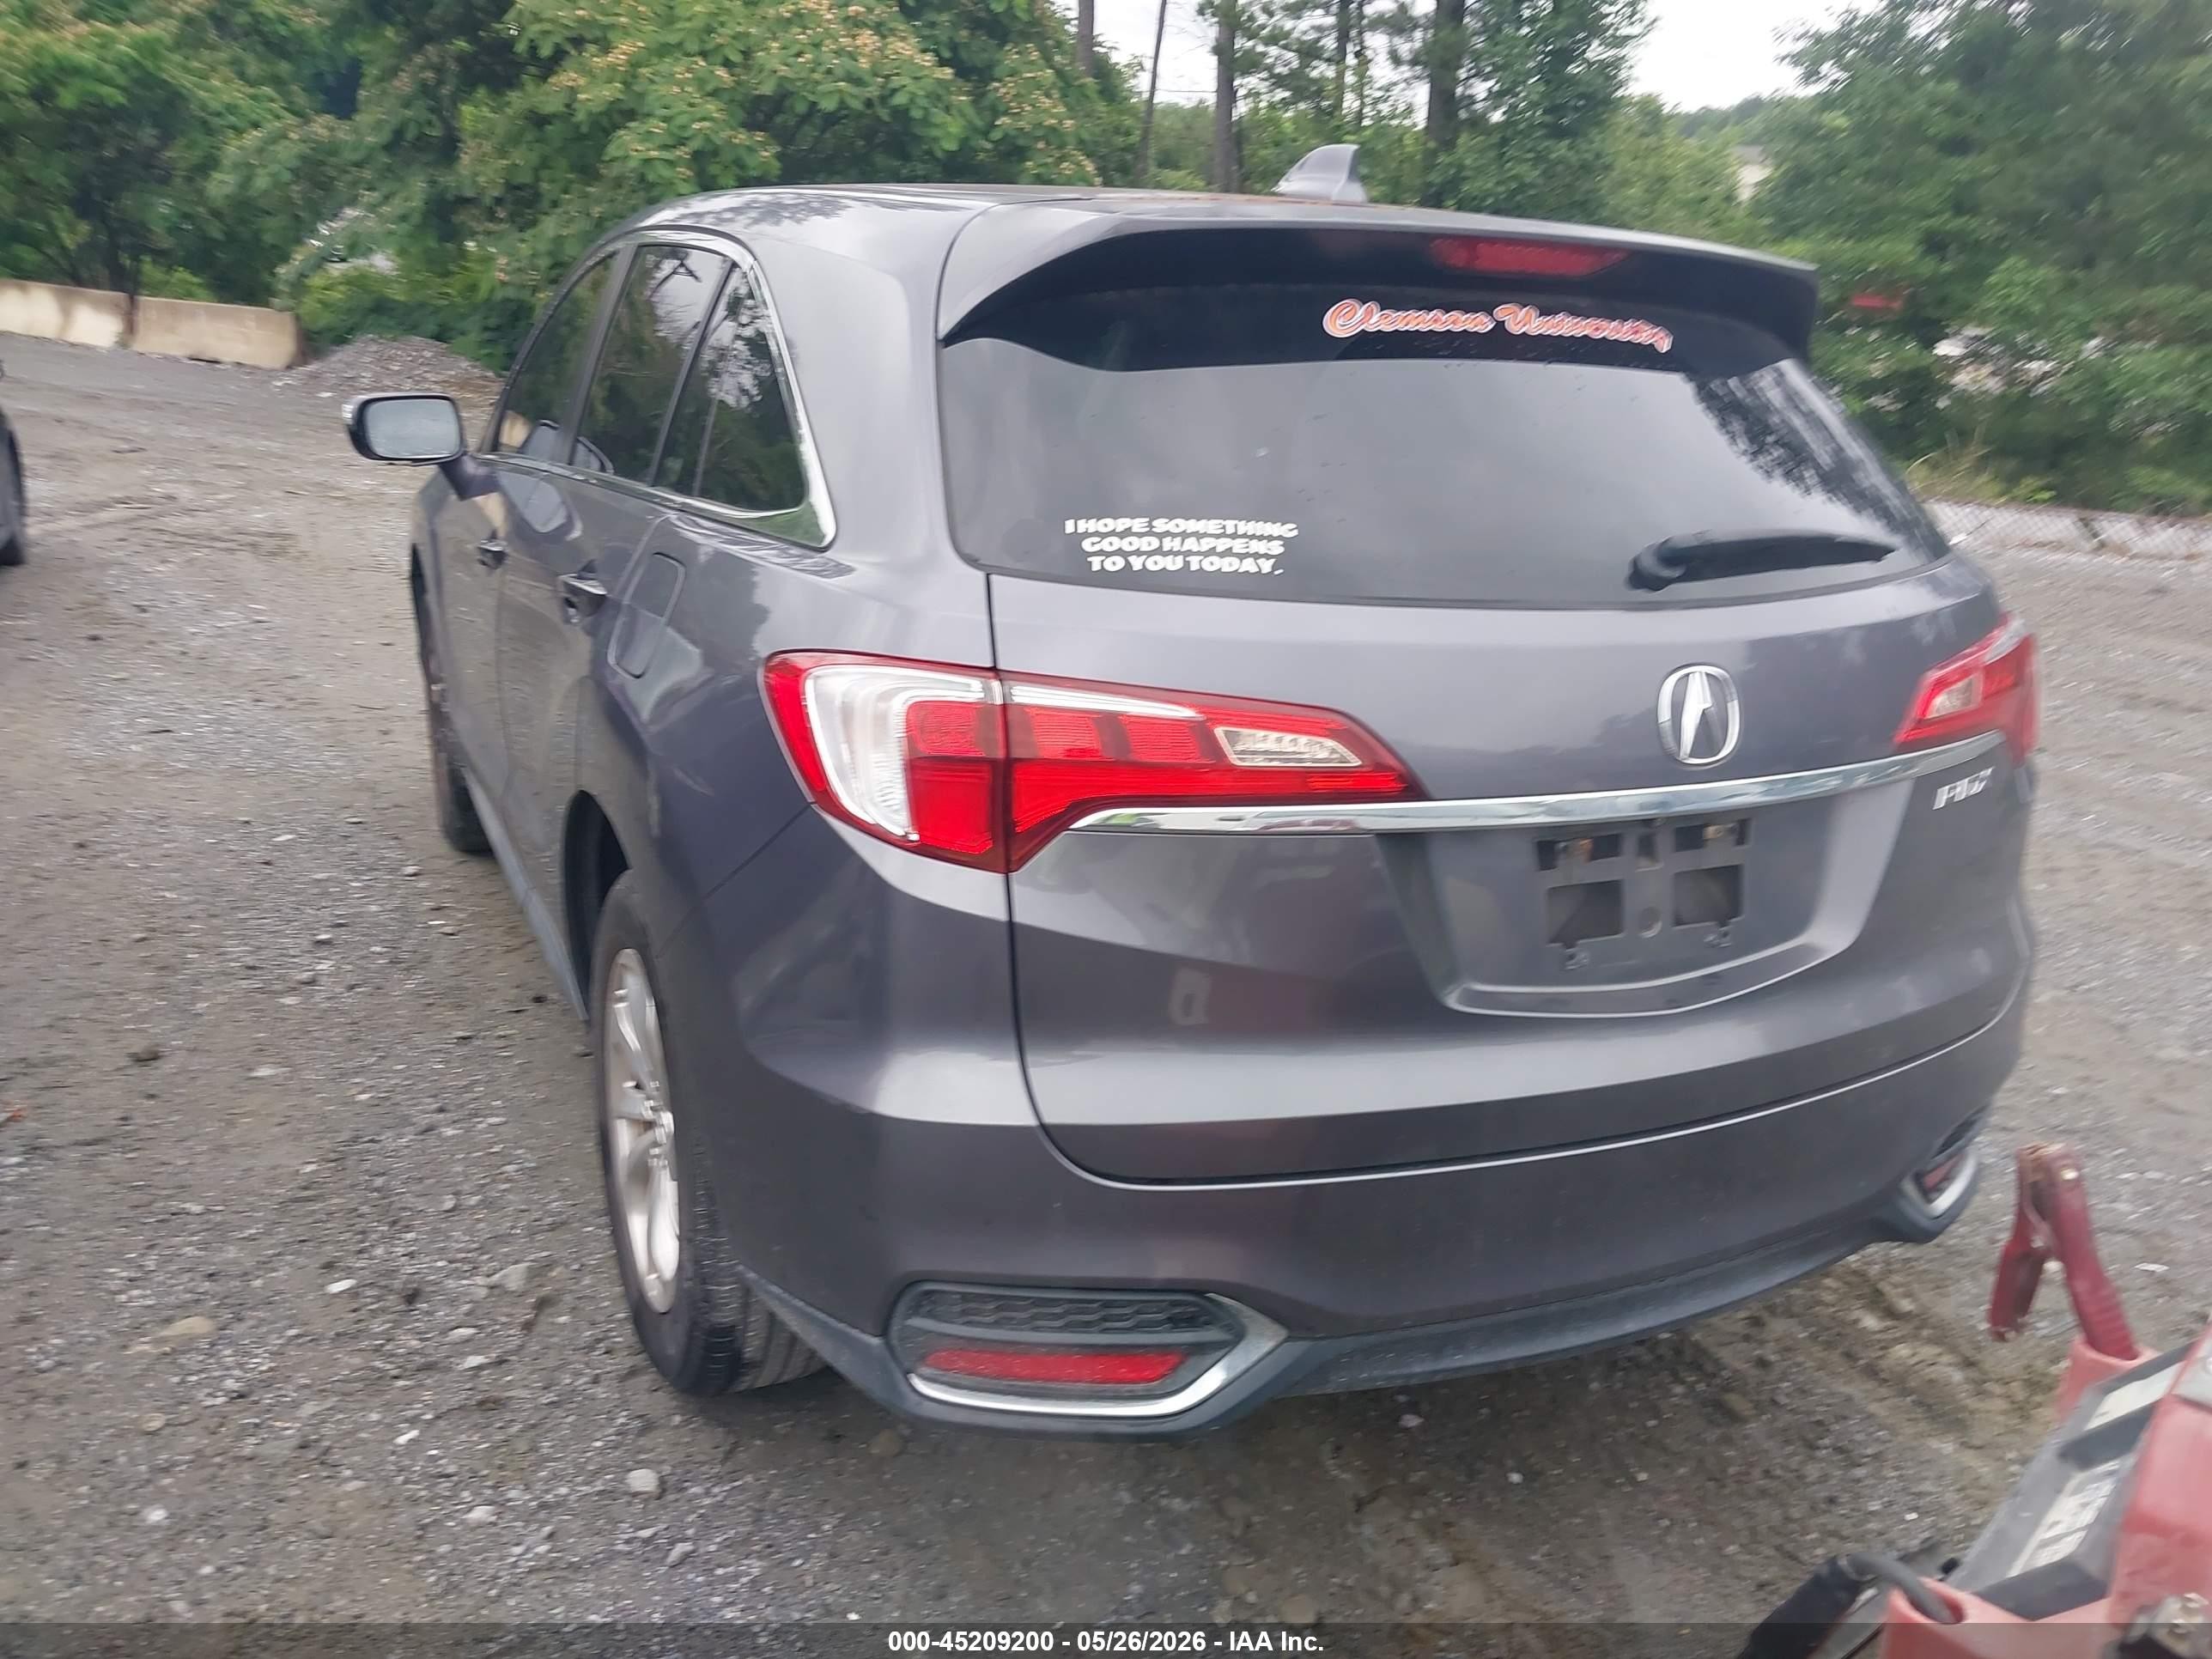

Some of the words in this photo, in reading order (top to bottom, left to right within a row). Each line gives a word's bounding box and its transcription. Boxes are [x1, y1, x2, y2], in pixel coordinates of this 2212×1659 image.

[1323, 299, 1496, 337] Clemson
[1064, 519, 1076, 534] I
[1076, 518, 1150, 533] HOPE
[1152, 519, 1298, 538] SOMETHING
[1081, 536, 1159, 552] GOOD
[1162, 537, 1285, 555] HAPPENS
[1087, 556, 1125, 572] TO
[1127, 555, 1184, 572] YOU
